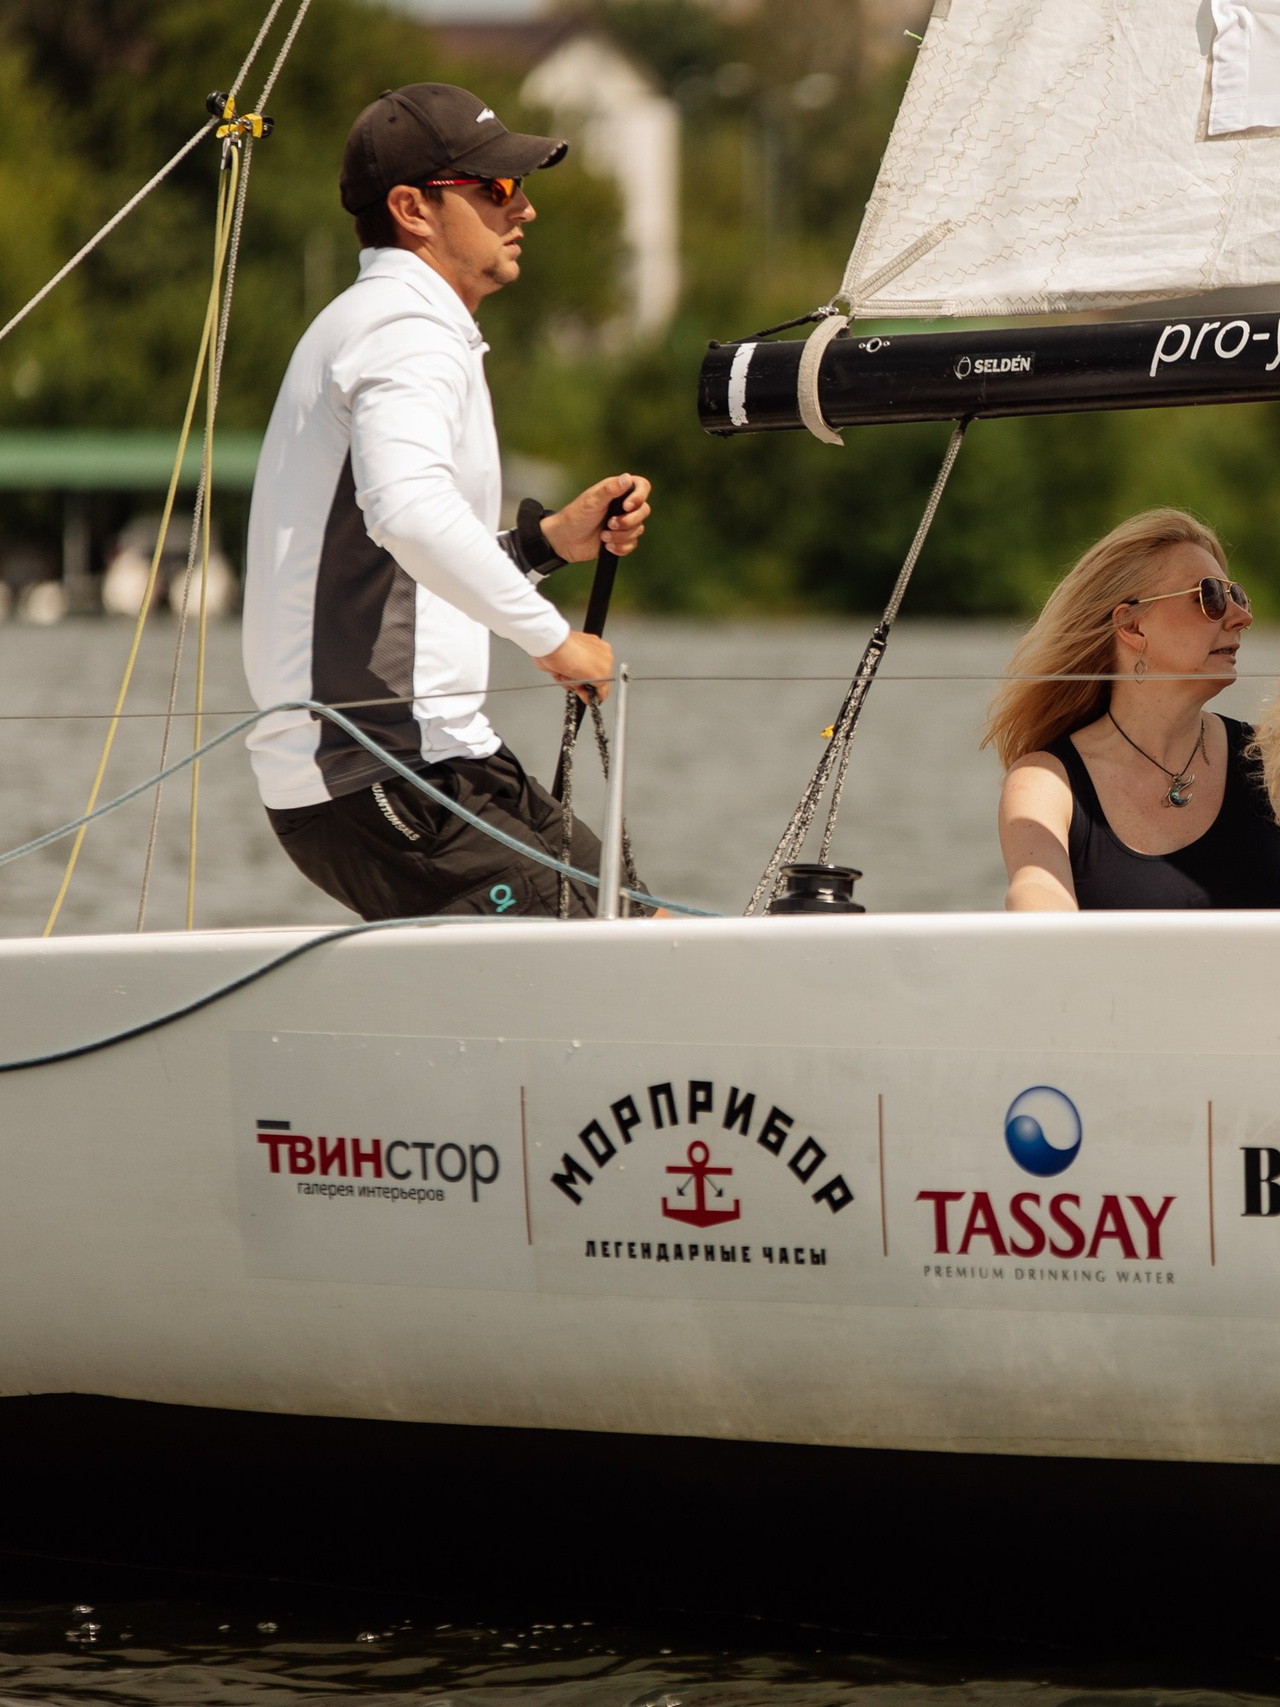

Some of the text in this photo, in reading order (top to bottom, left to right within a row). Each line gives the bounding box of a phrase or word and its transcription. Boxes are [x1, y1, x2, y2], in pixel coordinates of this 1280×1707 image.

[973, 354, 1031, 374] SELDÉN
[550, 1080, 855, 1215] МОРПРИБОР
[297, 1182, 445, 1204] галерея интерьеров
[915, 1190, 1178, 1260] TASSAY
[585, 1240, 826, 1265] ЛЕГЕНДАРНЫЕ ЧАСЫ
[923, 1265, 1175, 1285] PREMIUM DRINKING WATER
